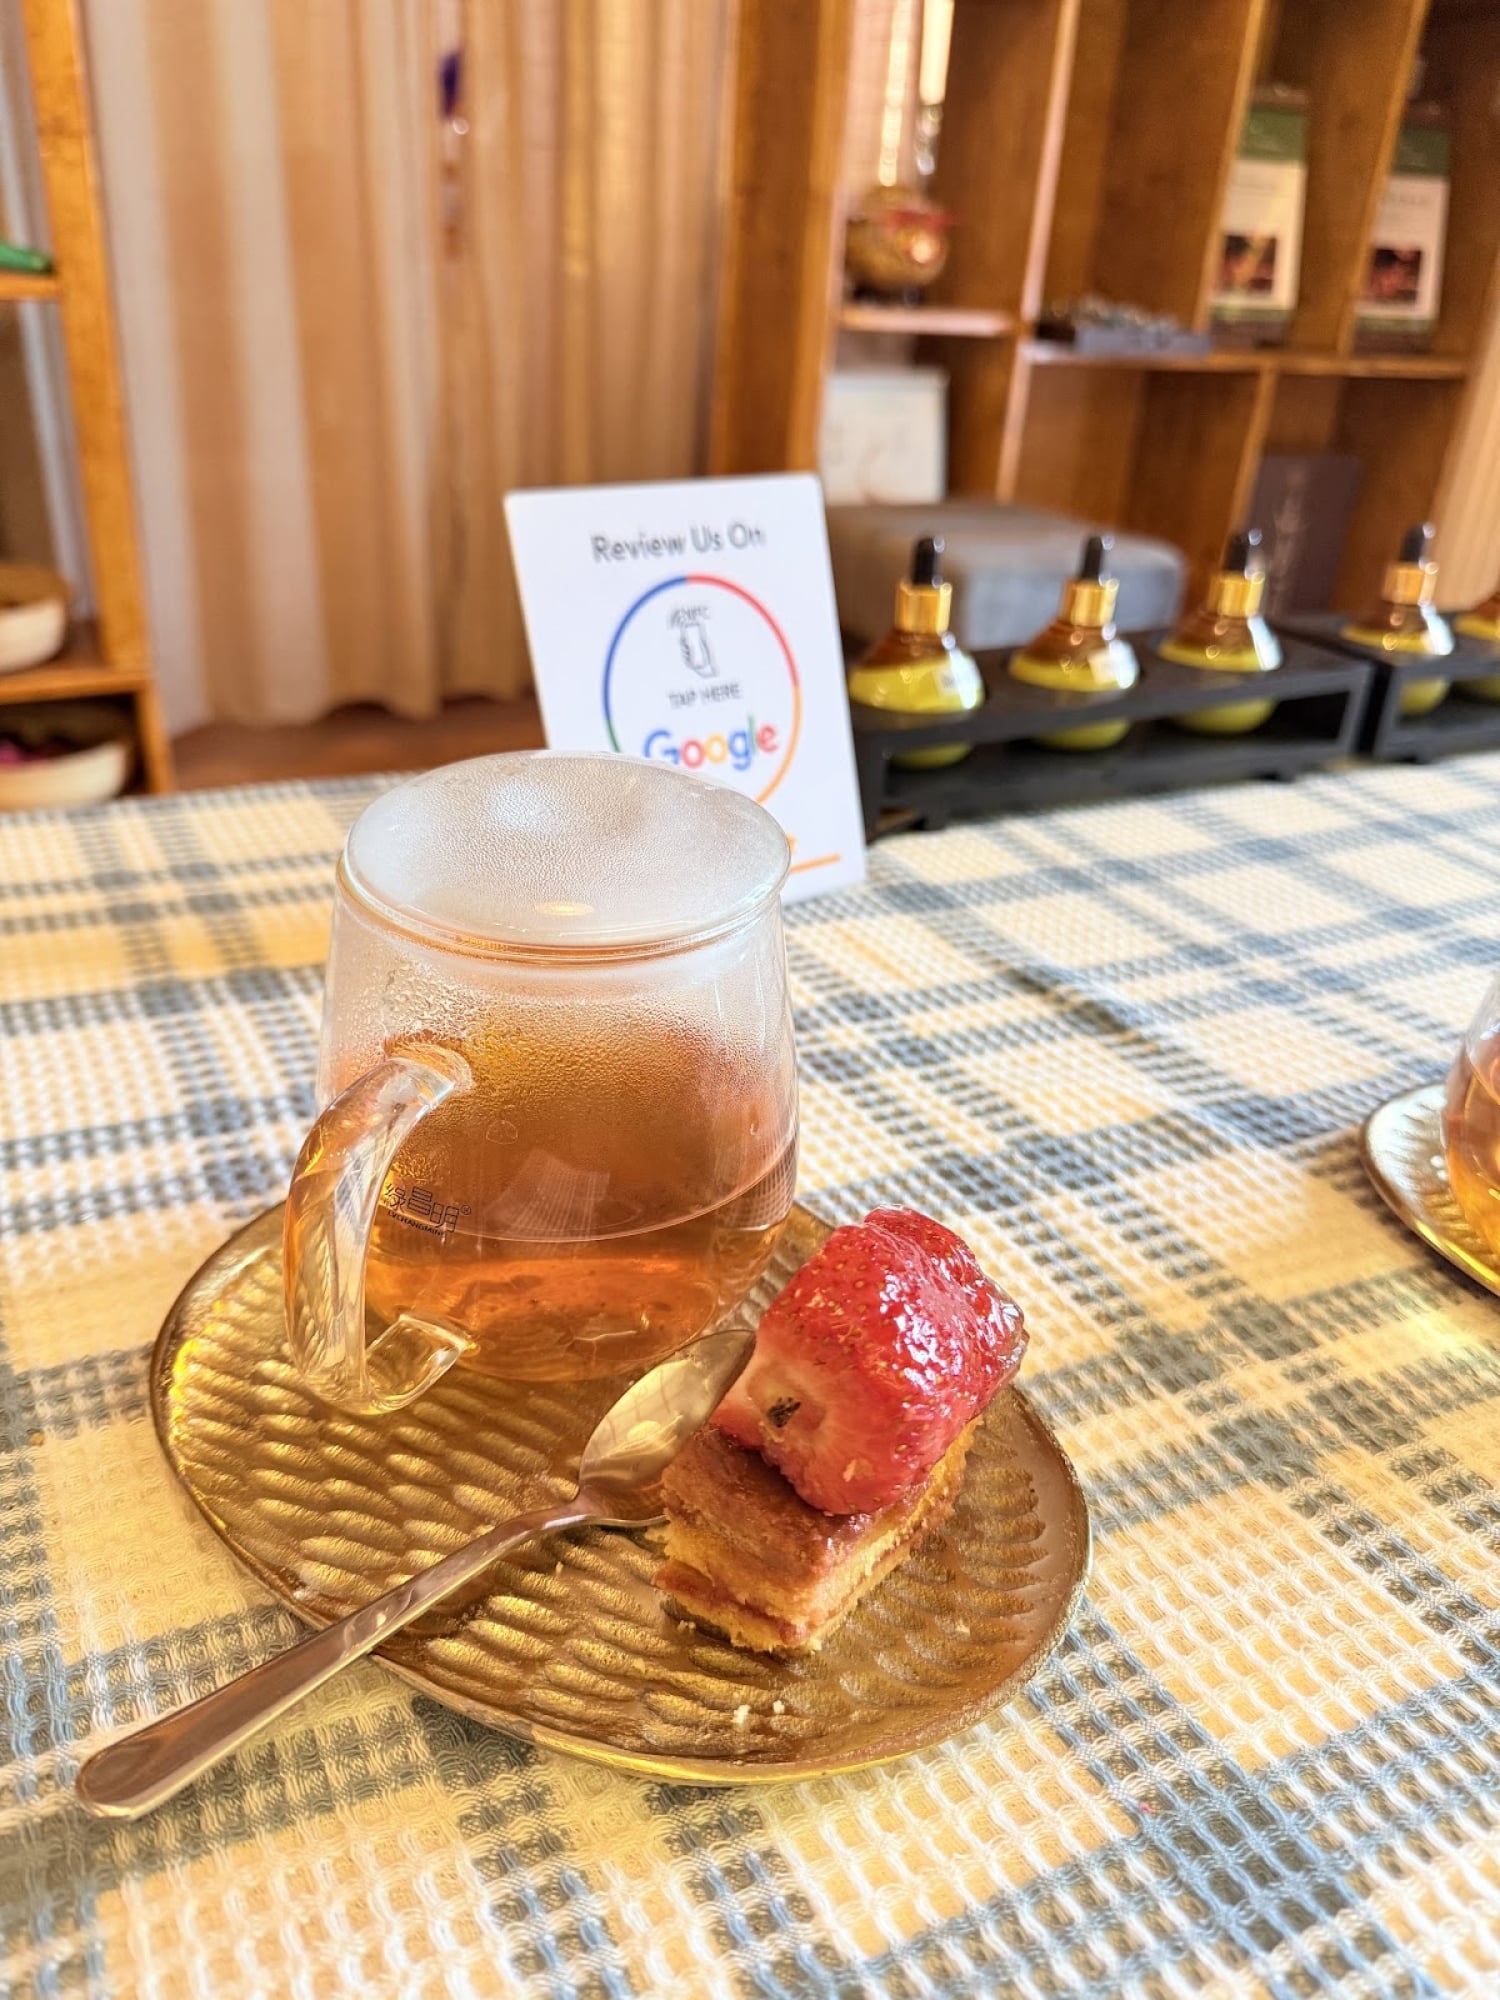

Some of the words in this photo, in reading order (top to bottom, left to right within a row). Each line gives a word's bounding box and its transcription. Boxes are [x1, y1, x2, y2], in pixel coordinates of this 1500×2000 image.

[591, 532, 686, 562] Review
[690, 525, 724, 553] Us
[727, 520, 766, 549] On
[668, 690, 698, 708] TAP
[700, 683, 741, 702] HERE
[643, 715, 779, 771] Google
